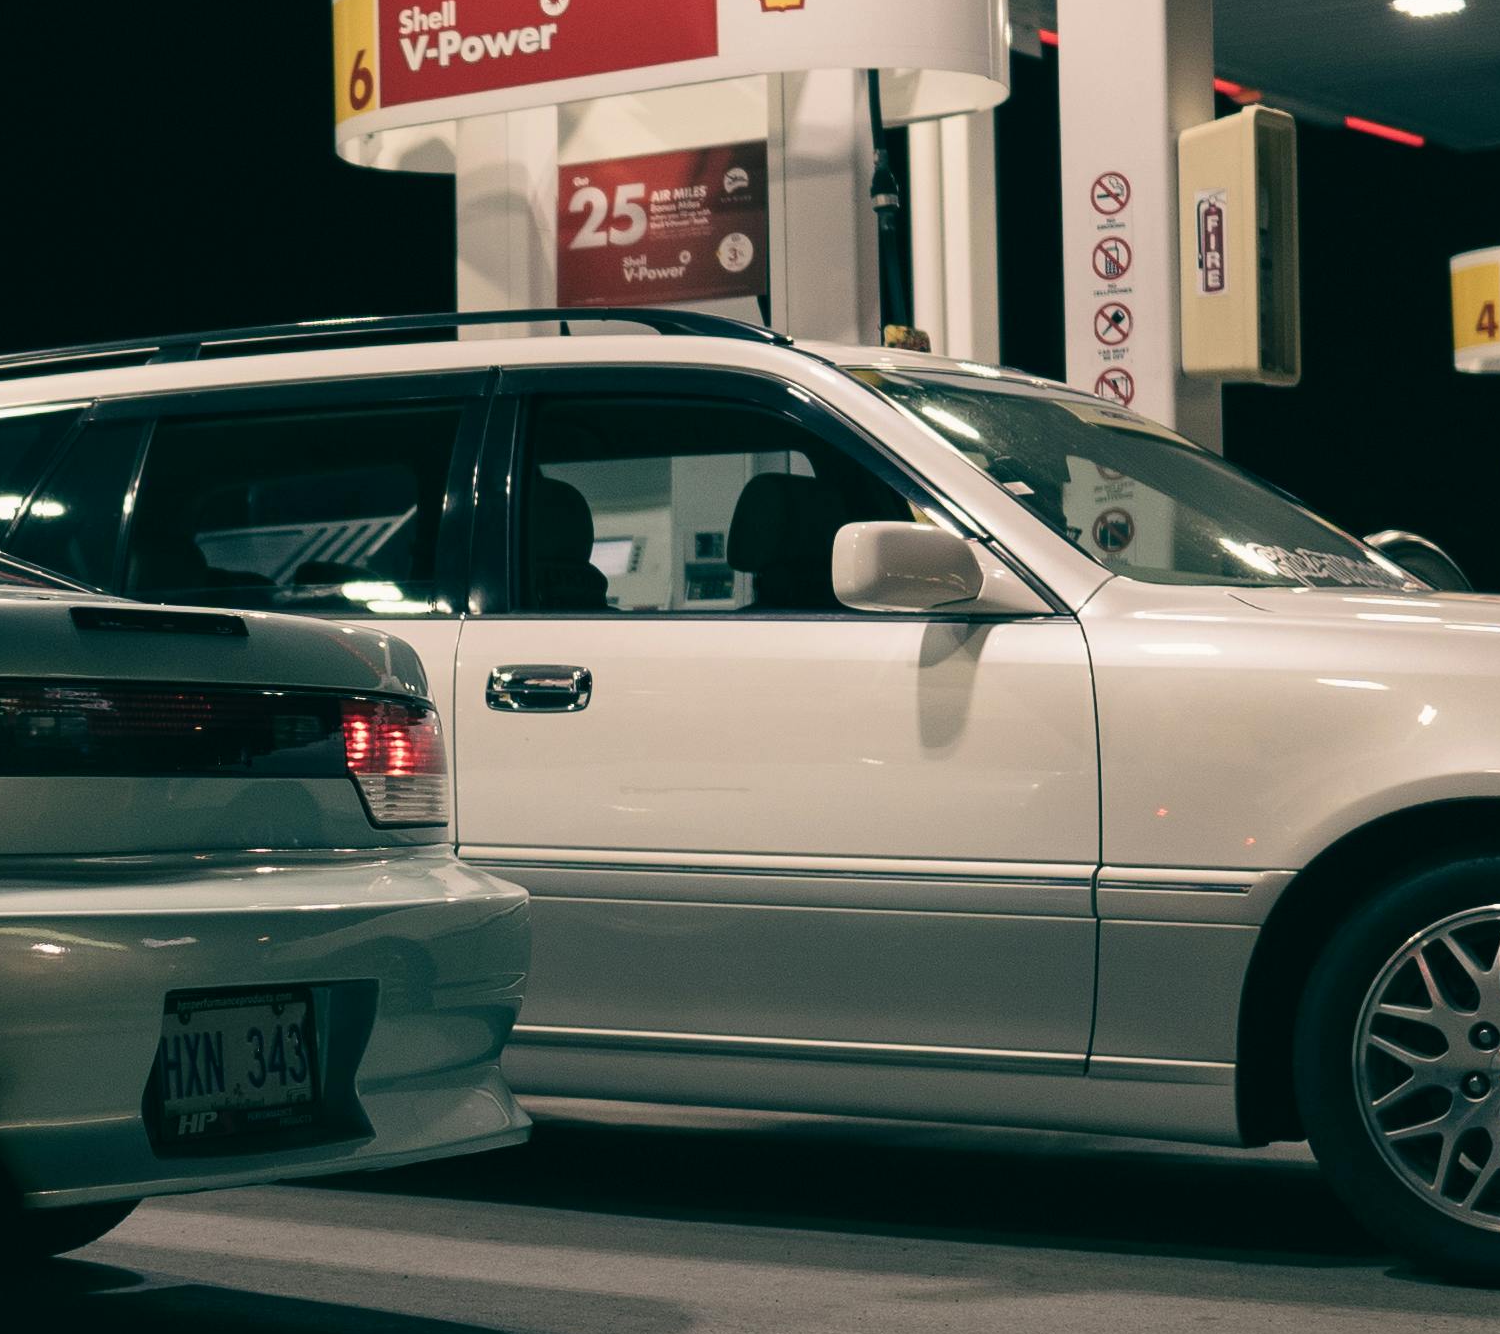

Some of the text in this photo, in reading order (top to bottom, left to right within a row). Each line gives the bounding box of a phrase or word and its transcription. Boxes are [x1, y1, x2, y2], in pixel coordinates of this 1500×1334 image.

[398, 0, 457, 35] Shell
[400, 23, 558, 72] V-Power
[349, 49, 374, 111] 6
[650, 190, 672, 203] AIR
[673, 185, 708, 200] MILES
[568, 183, 647, 250] 25
[623, 254, 647, 268] Shell
[1206, 215, 1221, 288] FIRE
[623, 267, 686, 283] V-Power
[1475, 301, 1499, 339] 4
[160, 1023, 308, 1101] HXN 343
